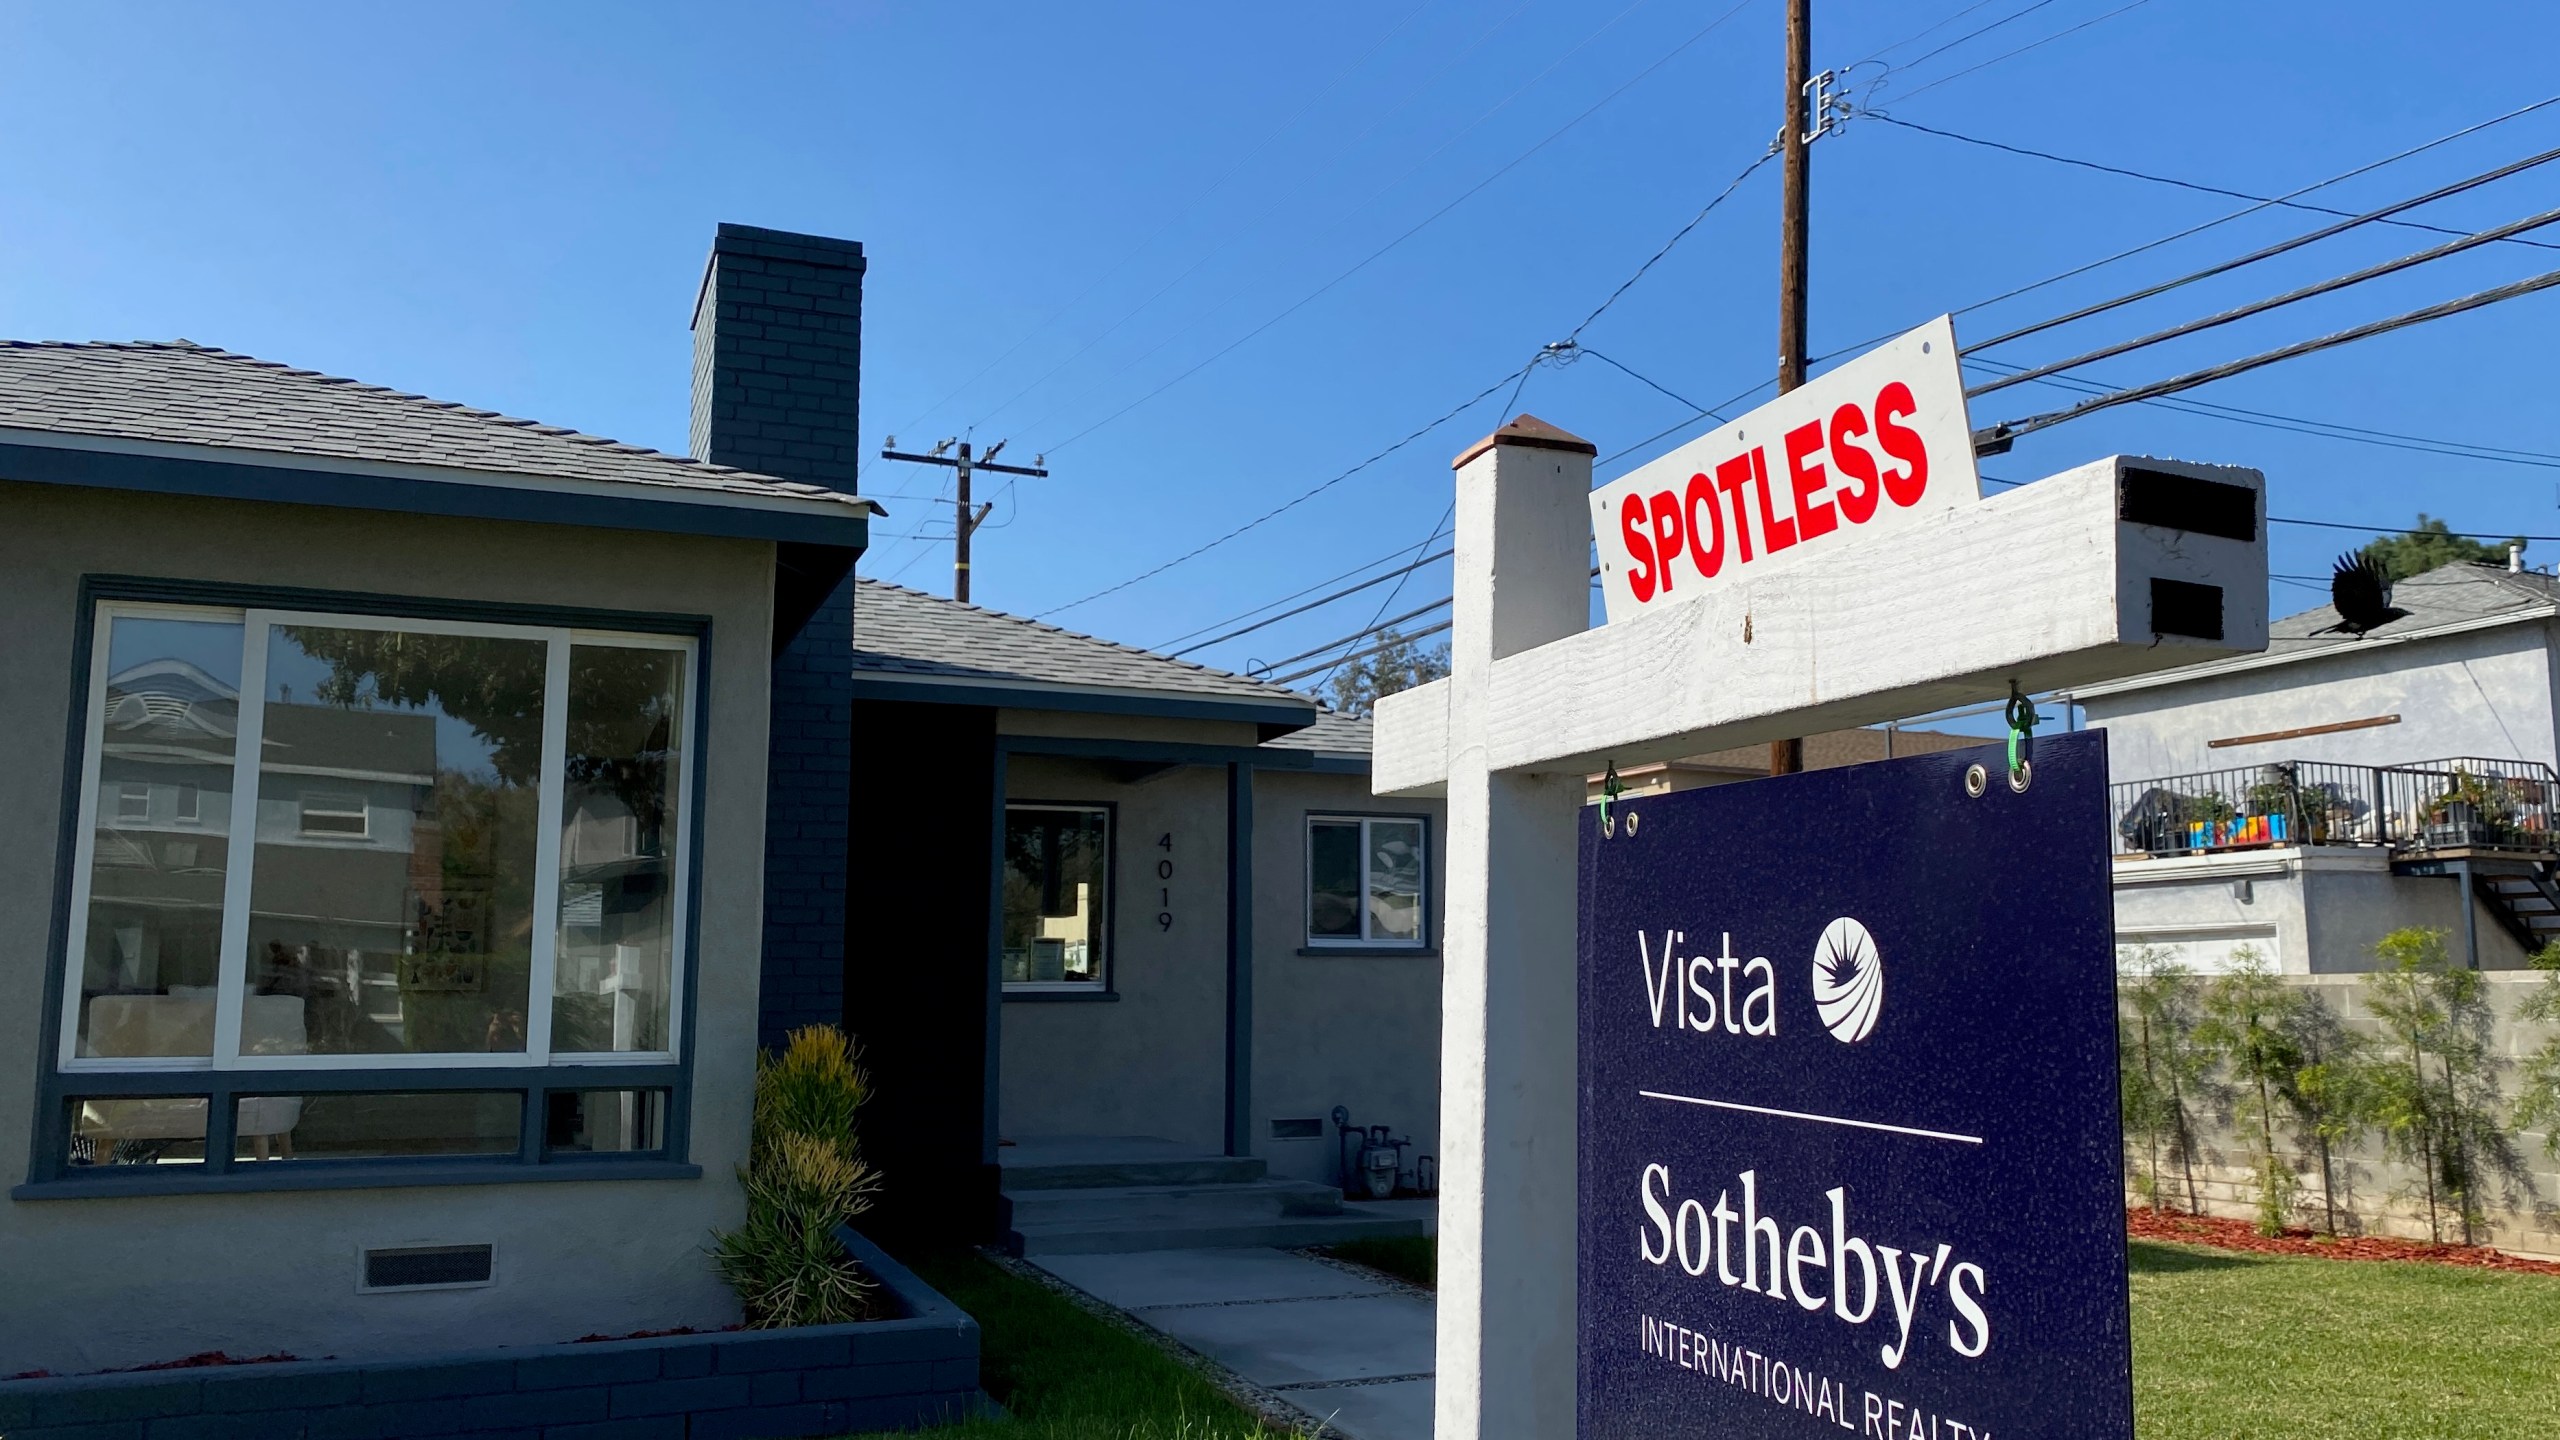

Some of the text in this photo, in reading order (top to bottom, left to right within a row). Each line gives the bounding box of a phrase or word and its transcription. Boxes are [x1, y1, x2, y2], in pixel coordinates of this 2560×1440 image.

[1621, 381, 1928, 603] SPOTLESS
[1157, 832, 1174, 933] 4019
[1637, 929, 1777, 1037] Vista
[1640, 1162, 1989, 1370] Sotheby's
[1641, 1313, 1991, 1440] INTERNATIONAL REA
